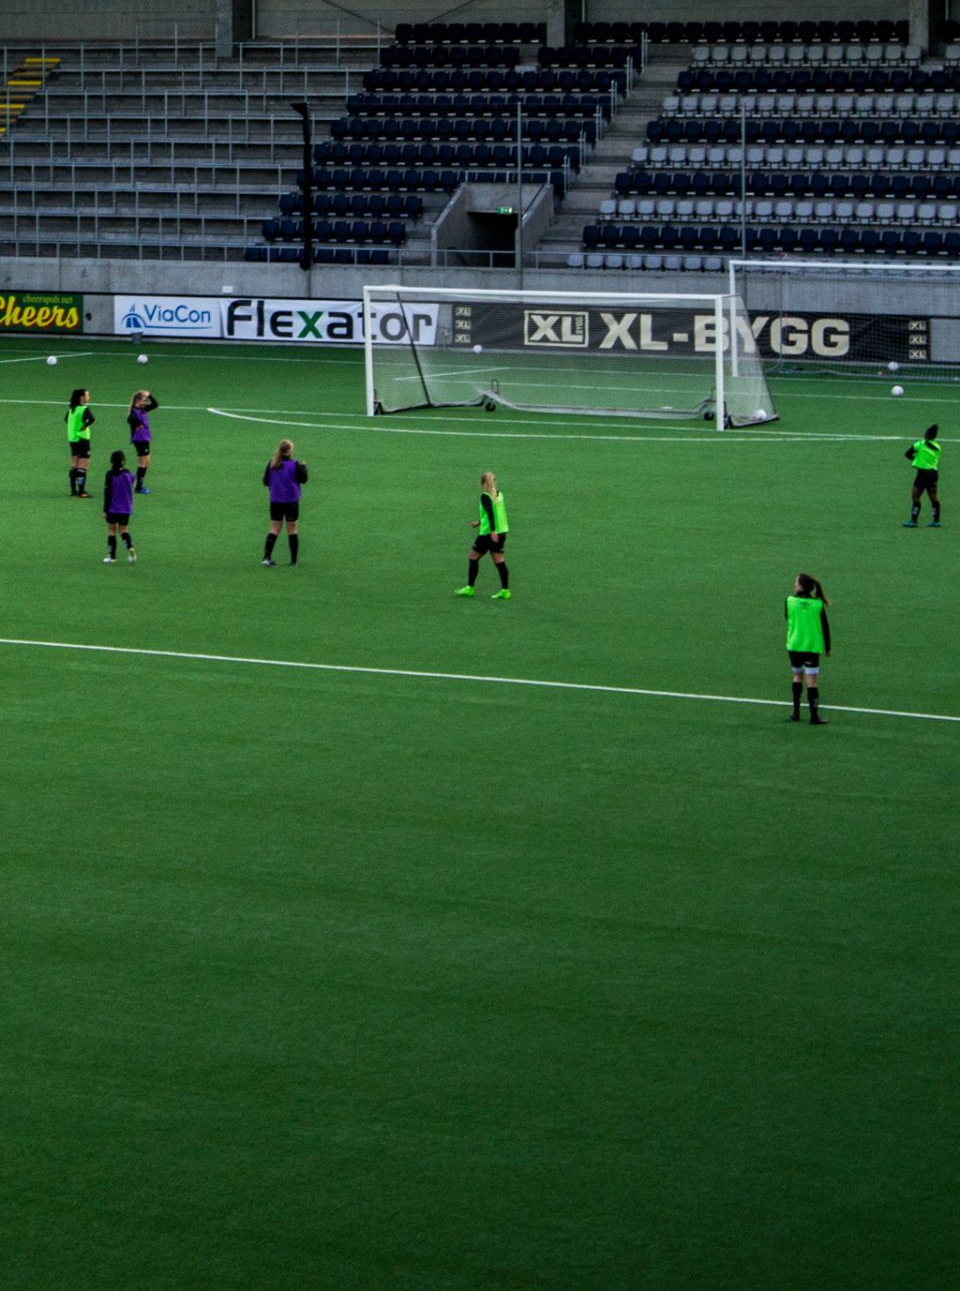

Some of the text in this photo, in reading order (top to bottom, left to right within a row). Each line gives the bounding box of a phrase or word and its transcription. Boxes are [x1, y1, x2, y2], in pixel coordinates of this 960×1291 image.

[144, 303, 211, 323] ViaCon
[529, 315, 583, 343] XL
[909, 320, 927, 331] XL
[599, 312, 850, 356] XL-BYGG
[909, 334, 927, 345] XL
[909, 349, 927, 360] XL
